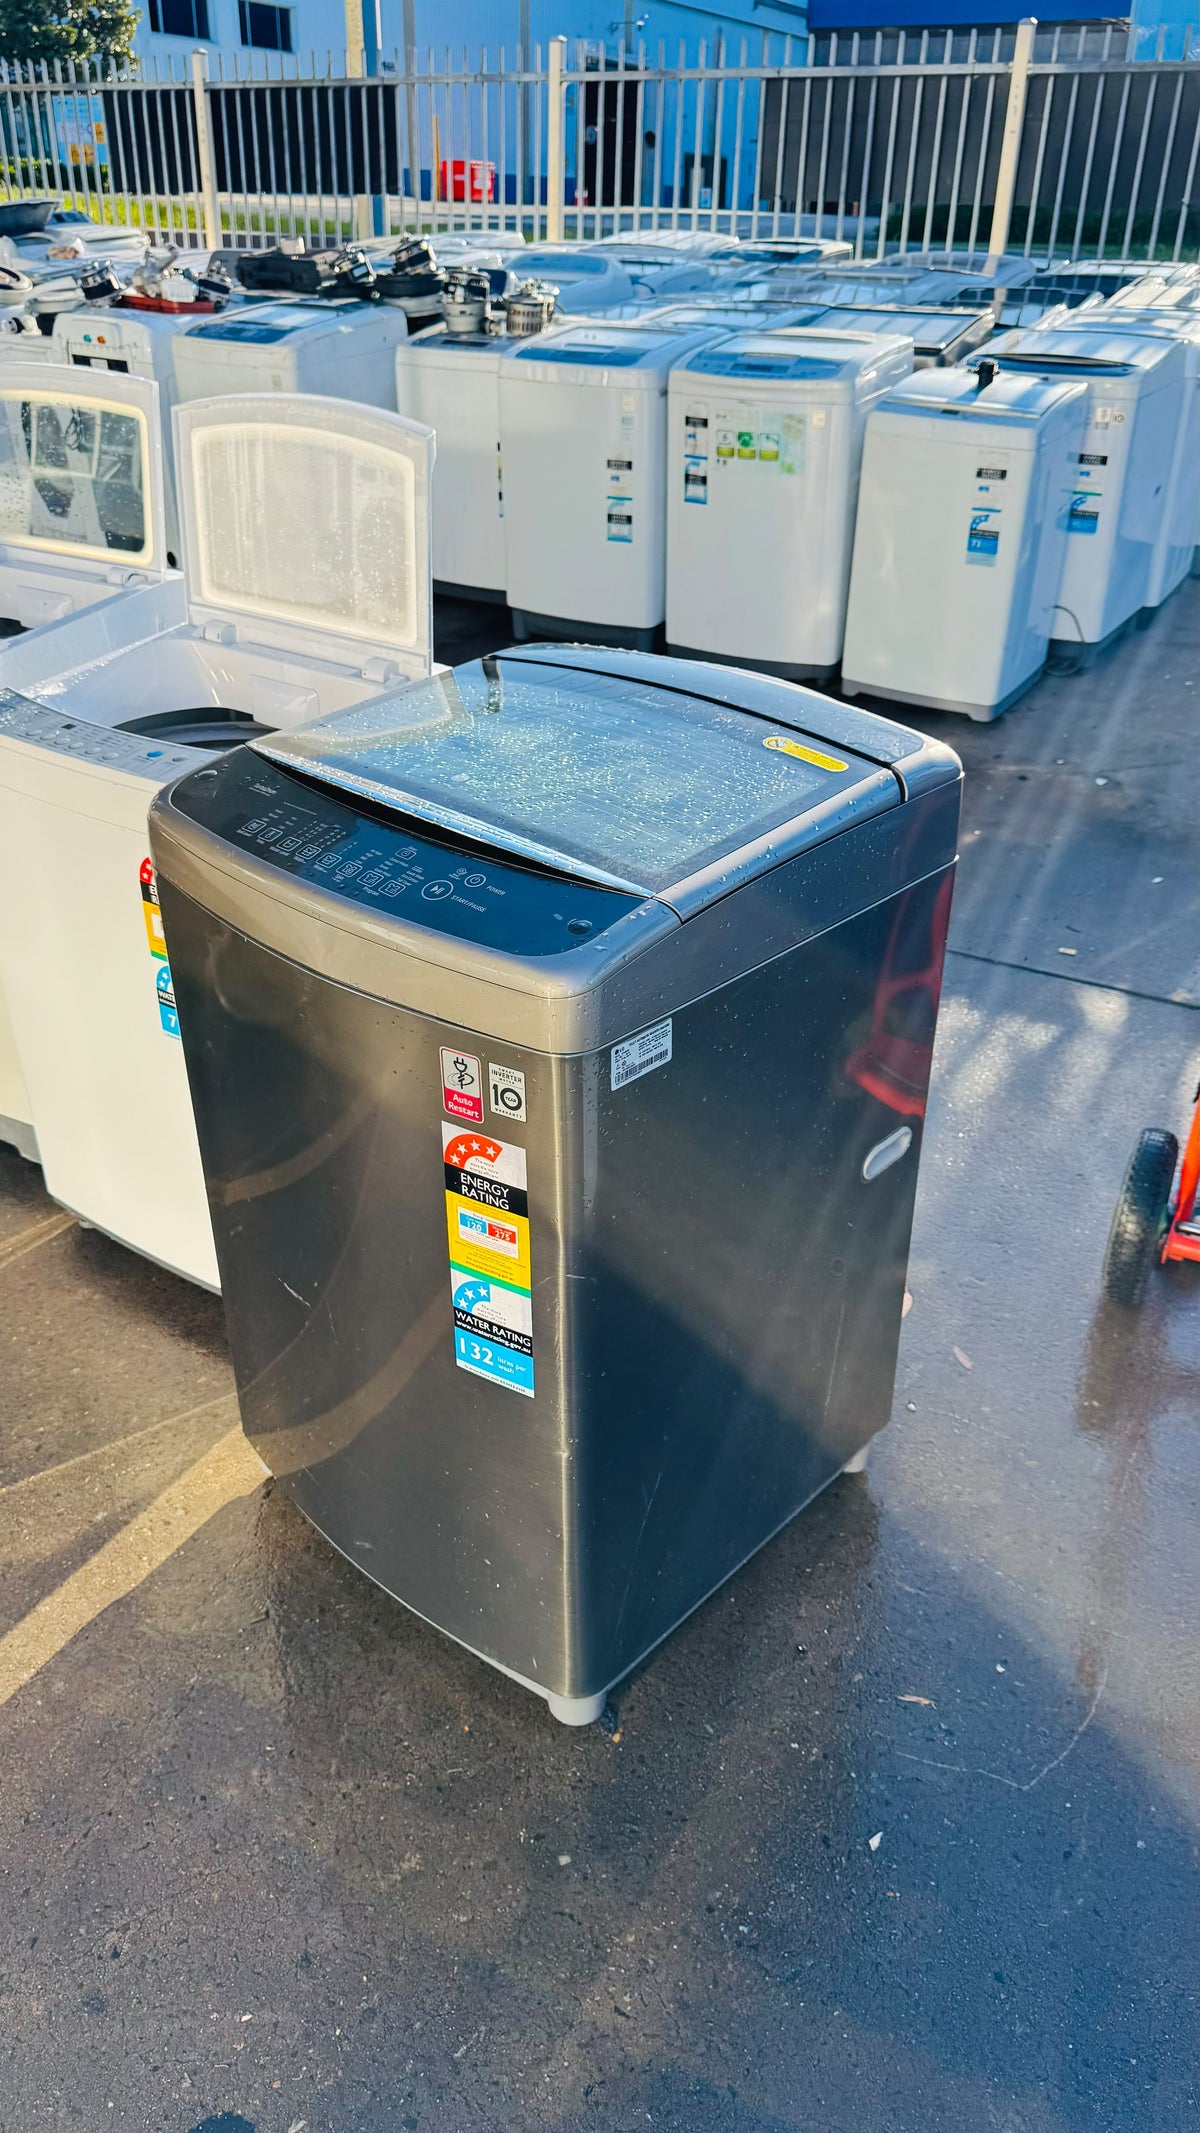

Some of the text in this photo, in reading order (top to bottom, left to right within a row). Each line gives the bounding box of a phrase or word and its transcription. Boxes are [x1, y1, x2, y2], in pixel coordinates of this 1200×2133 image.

[486, 885, 506, 896] POWER
[450, 895, 486, 913] START/PAUSE
[491, 1069, 522, 1084] INVERTER
[453, 1094, 473, 1107] Auto
[492, 1083, 522, 1111] 10
[448, 1101, 479, 1119] Restart
[460, 1173, 509, 1198] ENERGY
[461, 1185, 509, 1210] RATING
[467, 1221, 482, 1232] 120
[495, 1230, 510, 1241] 275
[455, 1310, 531, 1347] WATER RATING
[456, 1321, 531, 1354] www.waterrating.gov.au
[460, 1337, 494, 1366] 132
[497, 1356, 527, 1373] litres per
[497, 1364, 515, 1374] wash
